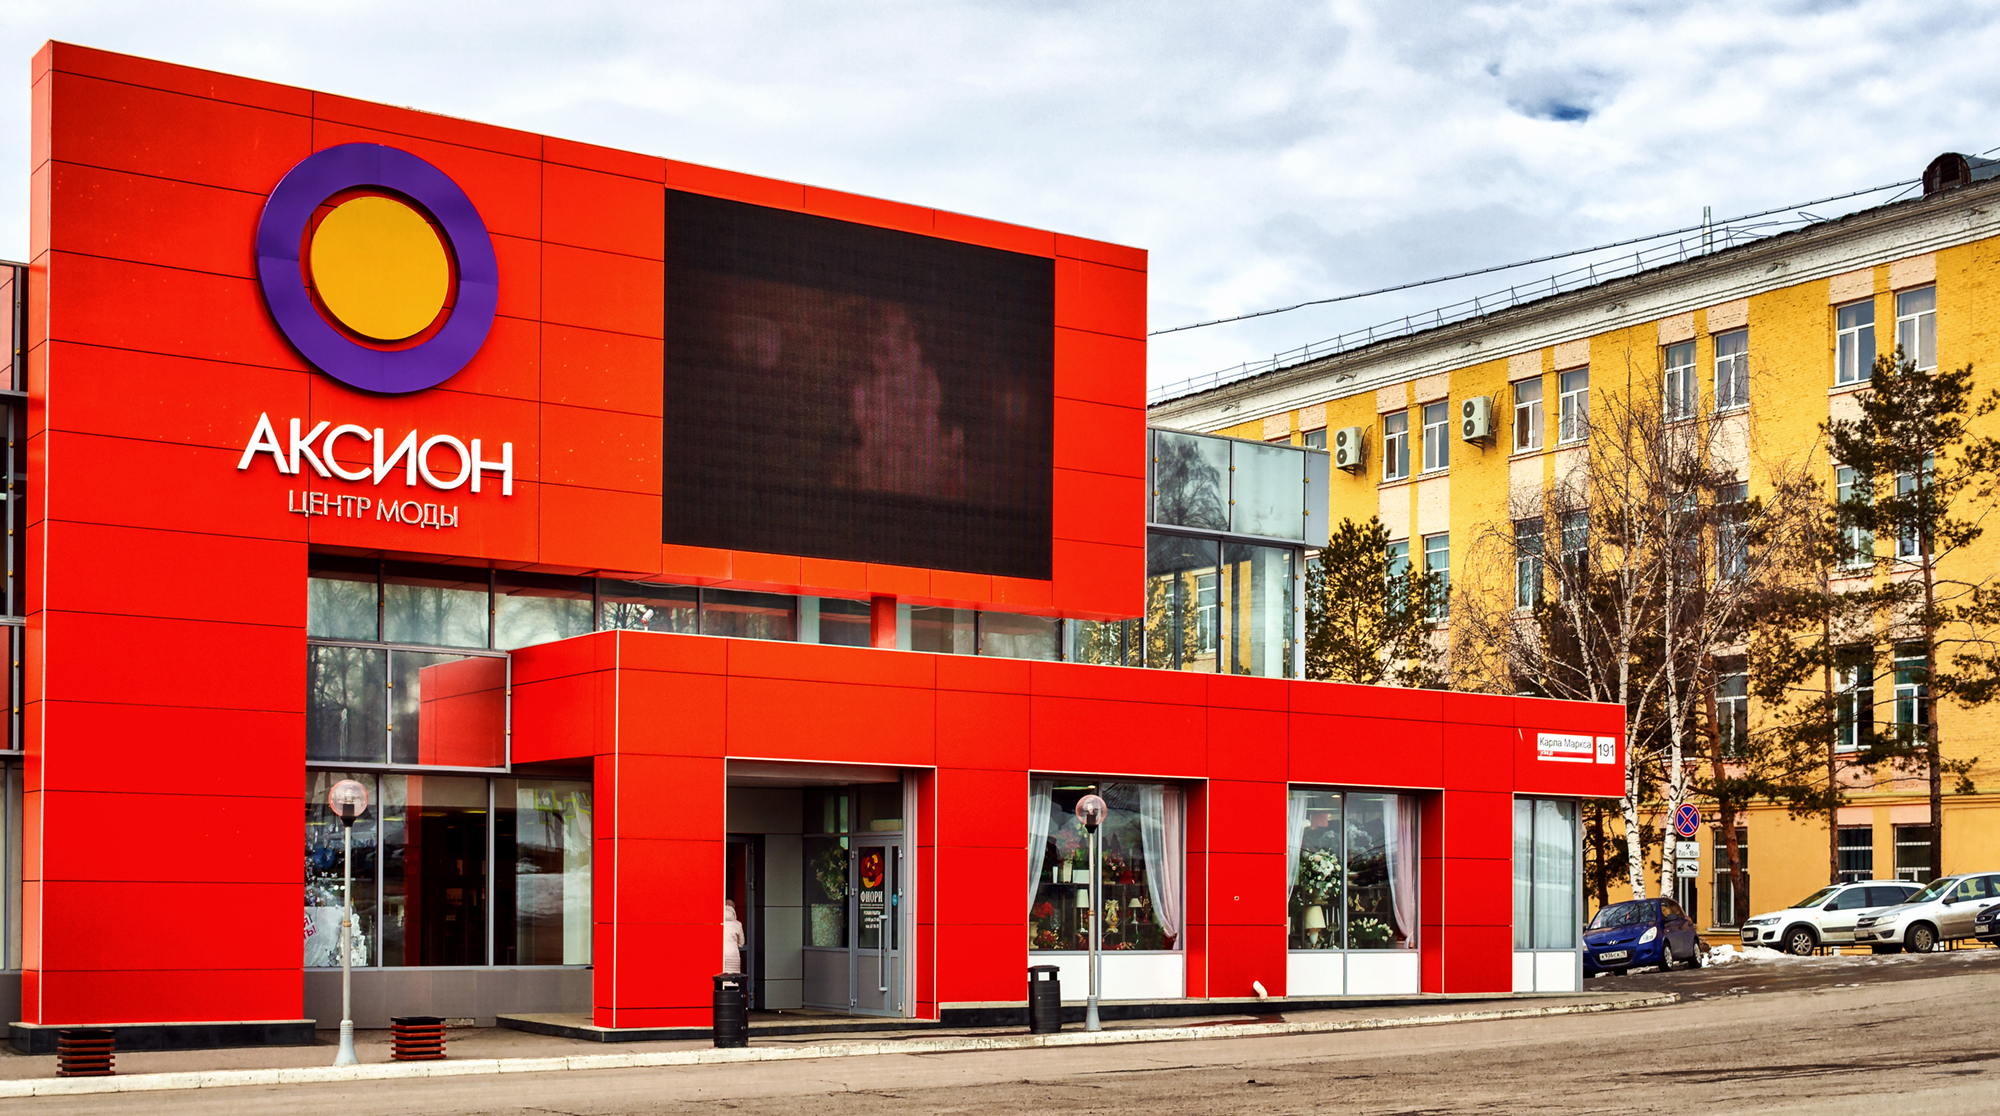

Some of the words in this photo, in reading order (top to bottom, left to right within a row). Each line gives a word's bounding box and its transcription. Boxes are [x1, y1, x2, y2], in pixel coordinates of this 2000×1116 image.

[237, 411, 513, 496] АКСИОН
[289, 490, 371, 518] ЦЕНТР
[376, 499, 458, 529] МОДЫ
[1539, 737, 1563, 748] Карла
[1564, 738, 1592, 750] Маркса
[1597, 743, 1615, 757] 191
[860, 890, 883, 903] ФИОРИ
